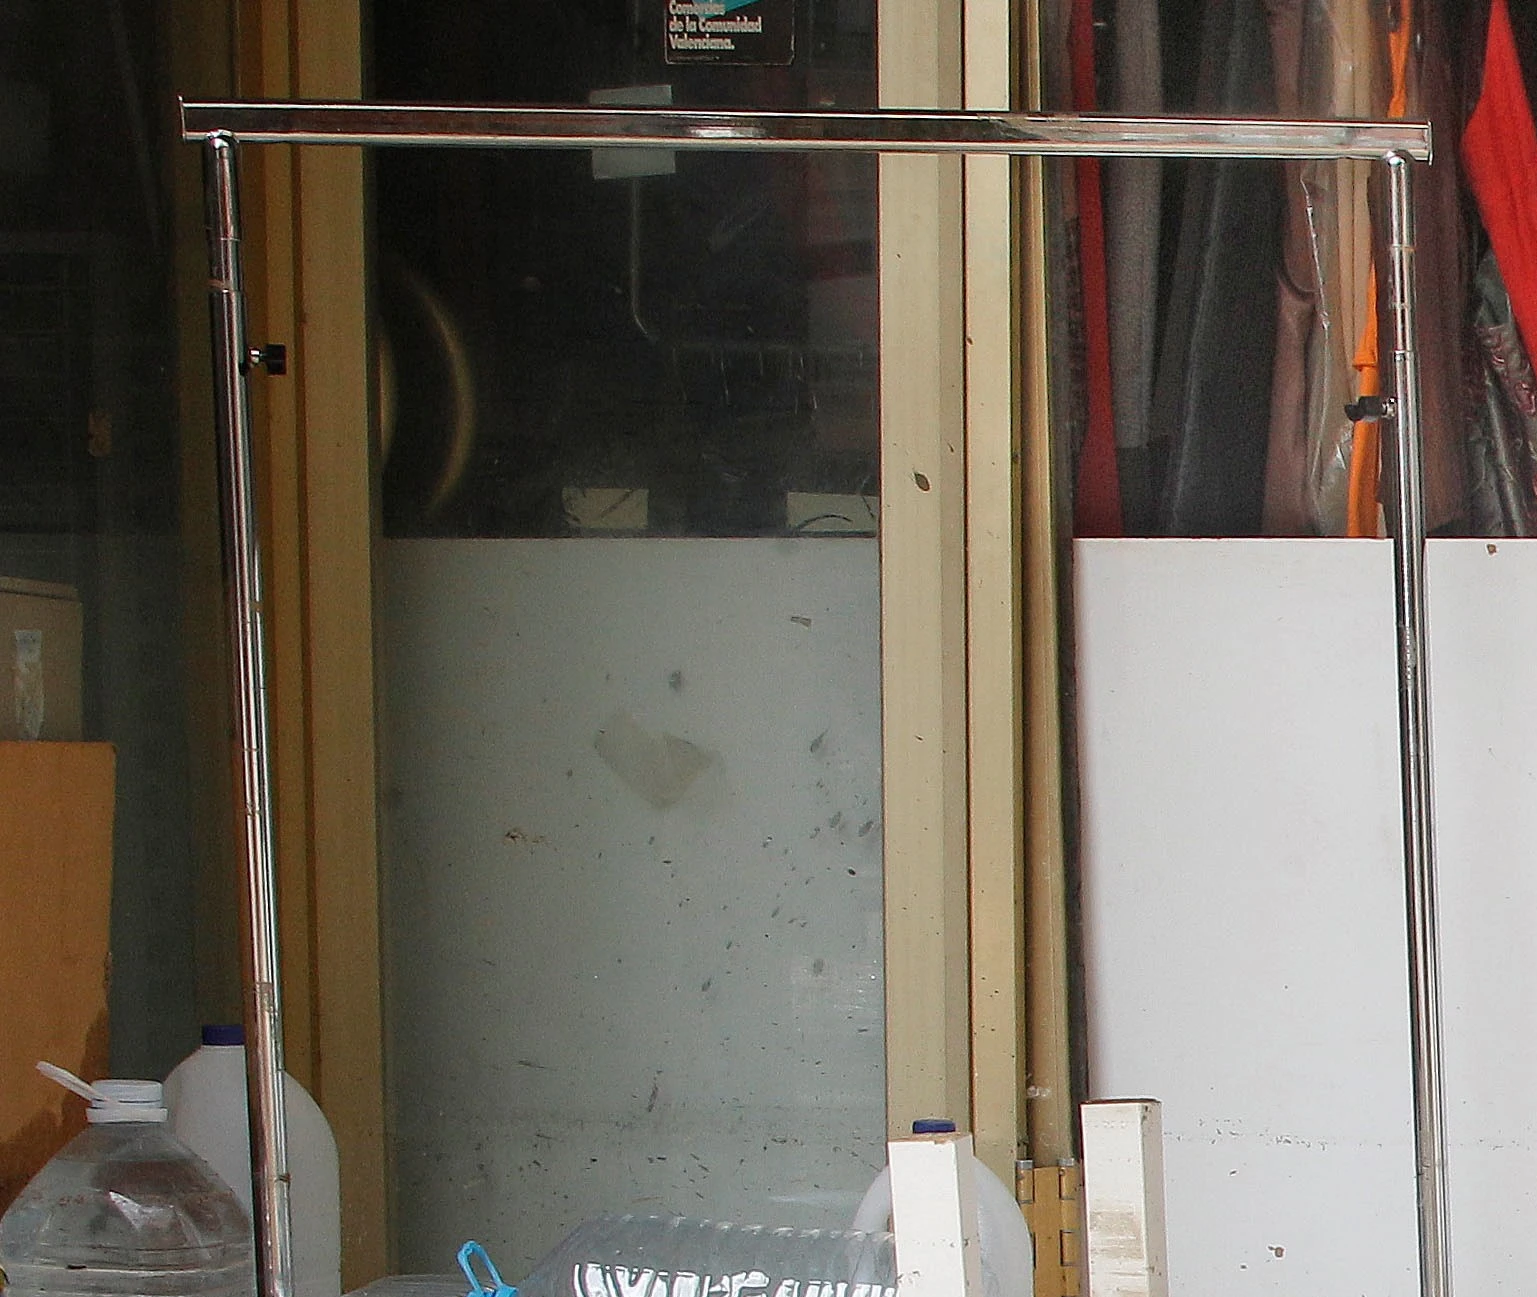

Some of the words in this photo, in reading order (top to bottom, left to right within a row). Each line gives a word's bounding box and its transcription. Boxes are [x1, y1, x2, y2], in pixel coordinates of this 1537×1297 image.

[669, 16, 684, 32] de
[686, 16, 697, 32] la
[699, 16, 762, 33] Comunidad
[668, 33, 736, 50] Valenciana.
